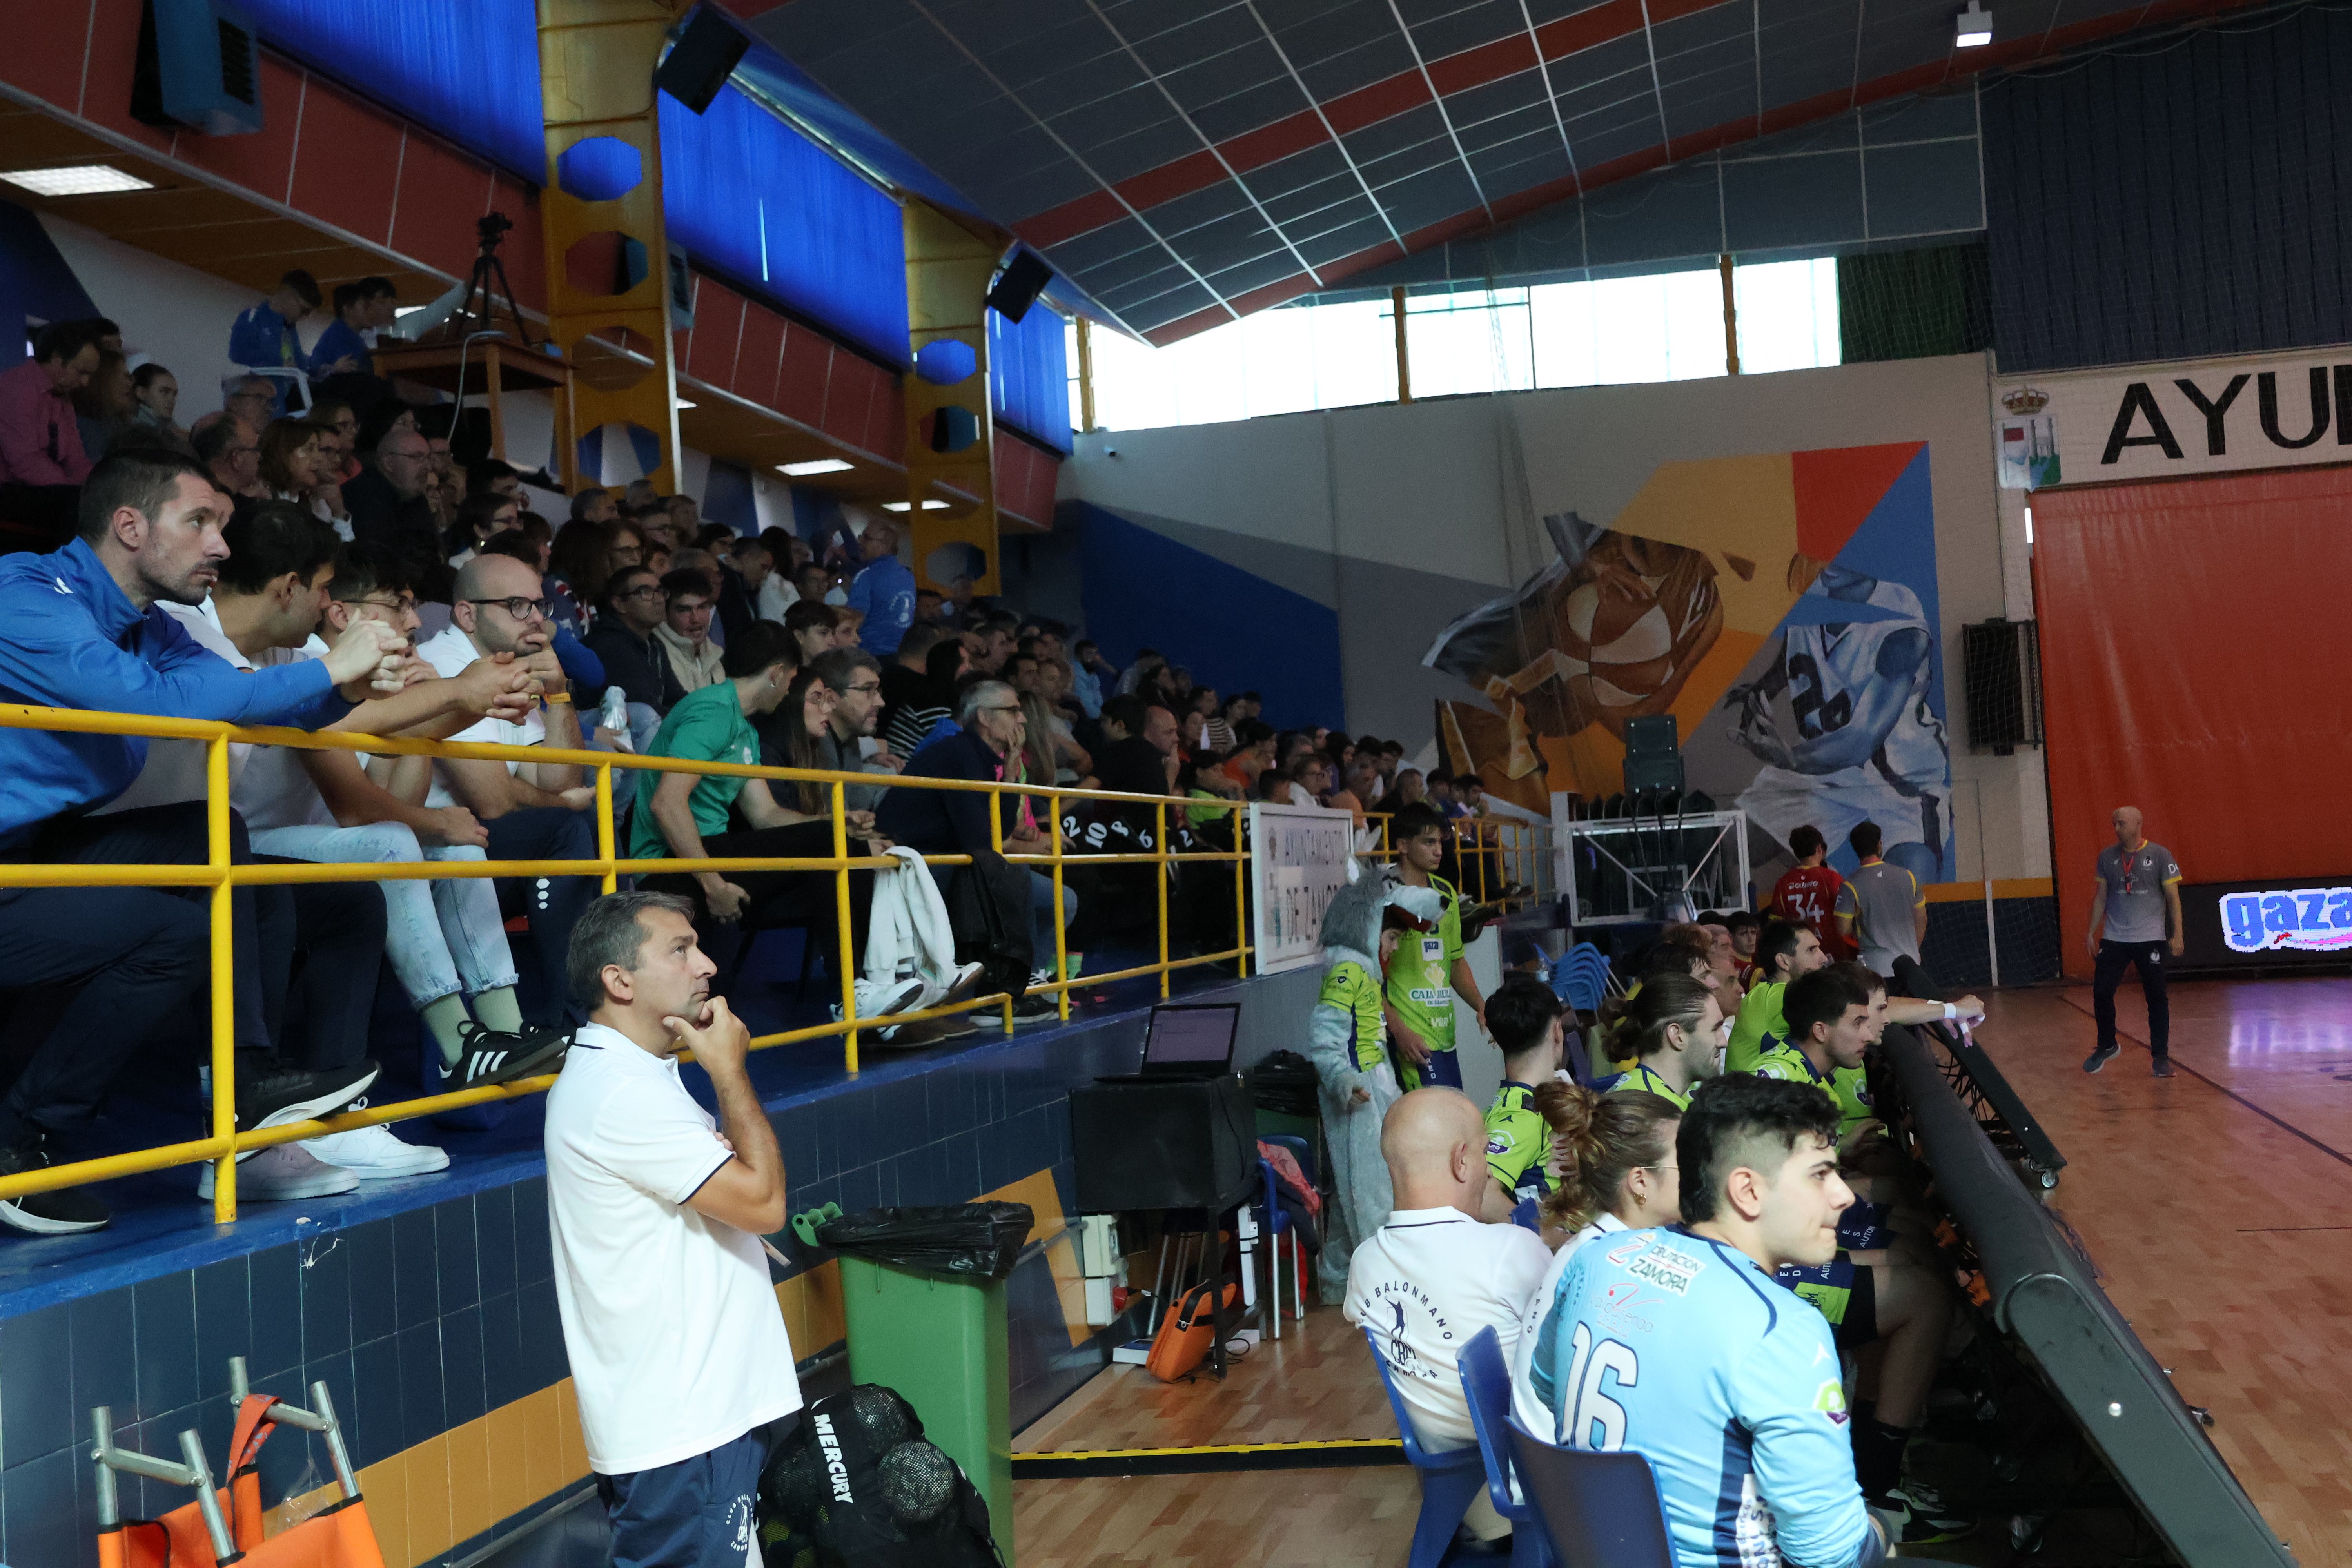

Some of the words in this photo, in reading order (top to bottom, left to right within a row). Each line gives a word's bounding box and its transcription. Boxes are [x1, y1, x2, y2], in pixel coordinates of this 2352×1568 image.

[1787, 892, 1825, 923] 34
[1629, 1258, 1688, 1293] ZAMORA
[1374, 1280, 1452, 1339] BALONMANO
[1558, 1320, 1639, 1451] 16
[813, 1414, 854, 1504] MERCURY
